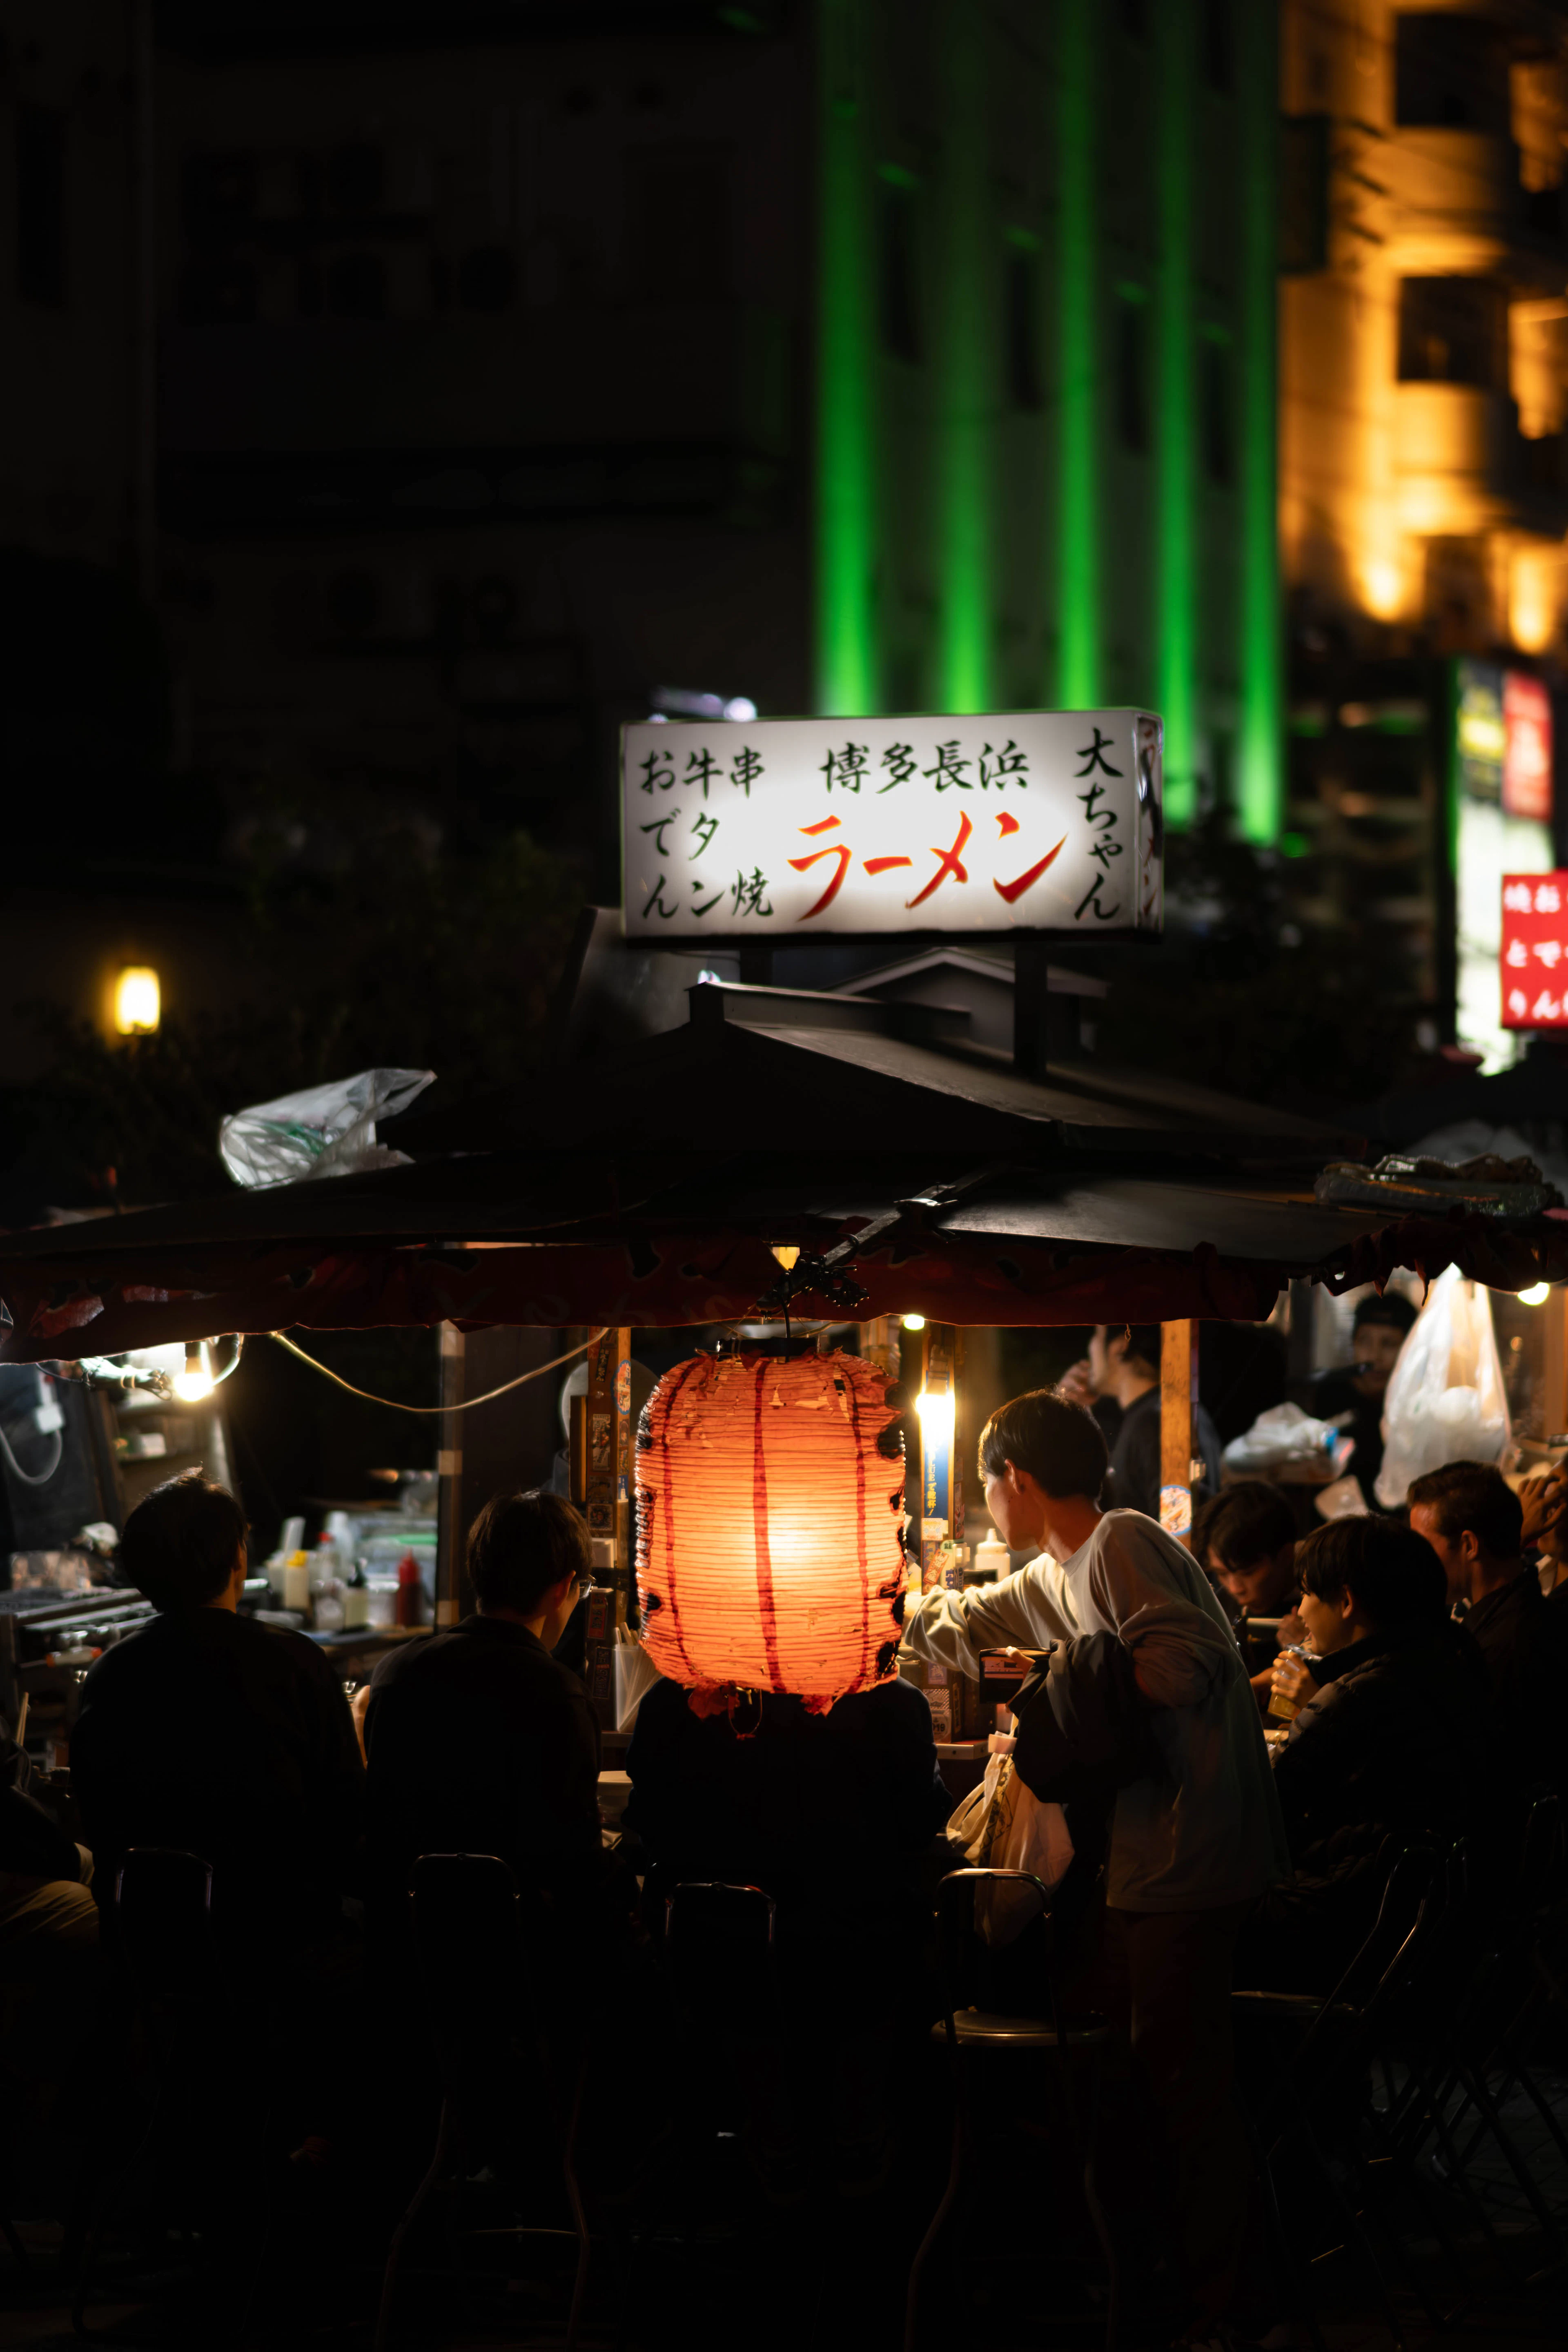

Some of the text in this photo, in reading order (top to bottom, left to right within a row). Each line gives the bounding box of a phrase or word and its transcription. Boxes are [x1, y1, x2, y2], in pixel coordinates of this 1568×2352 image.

[639, 750, 681, 920] おでん
[819, 740, 1030, 794] 博多長浜
[1073, 727, 1126, 922] 大ちゃん
[786, 810, 1069, 923] ラーメン
